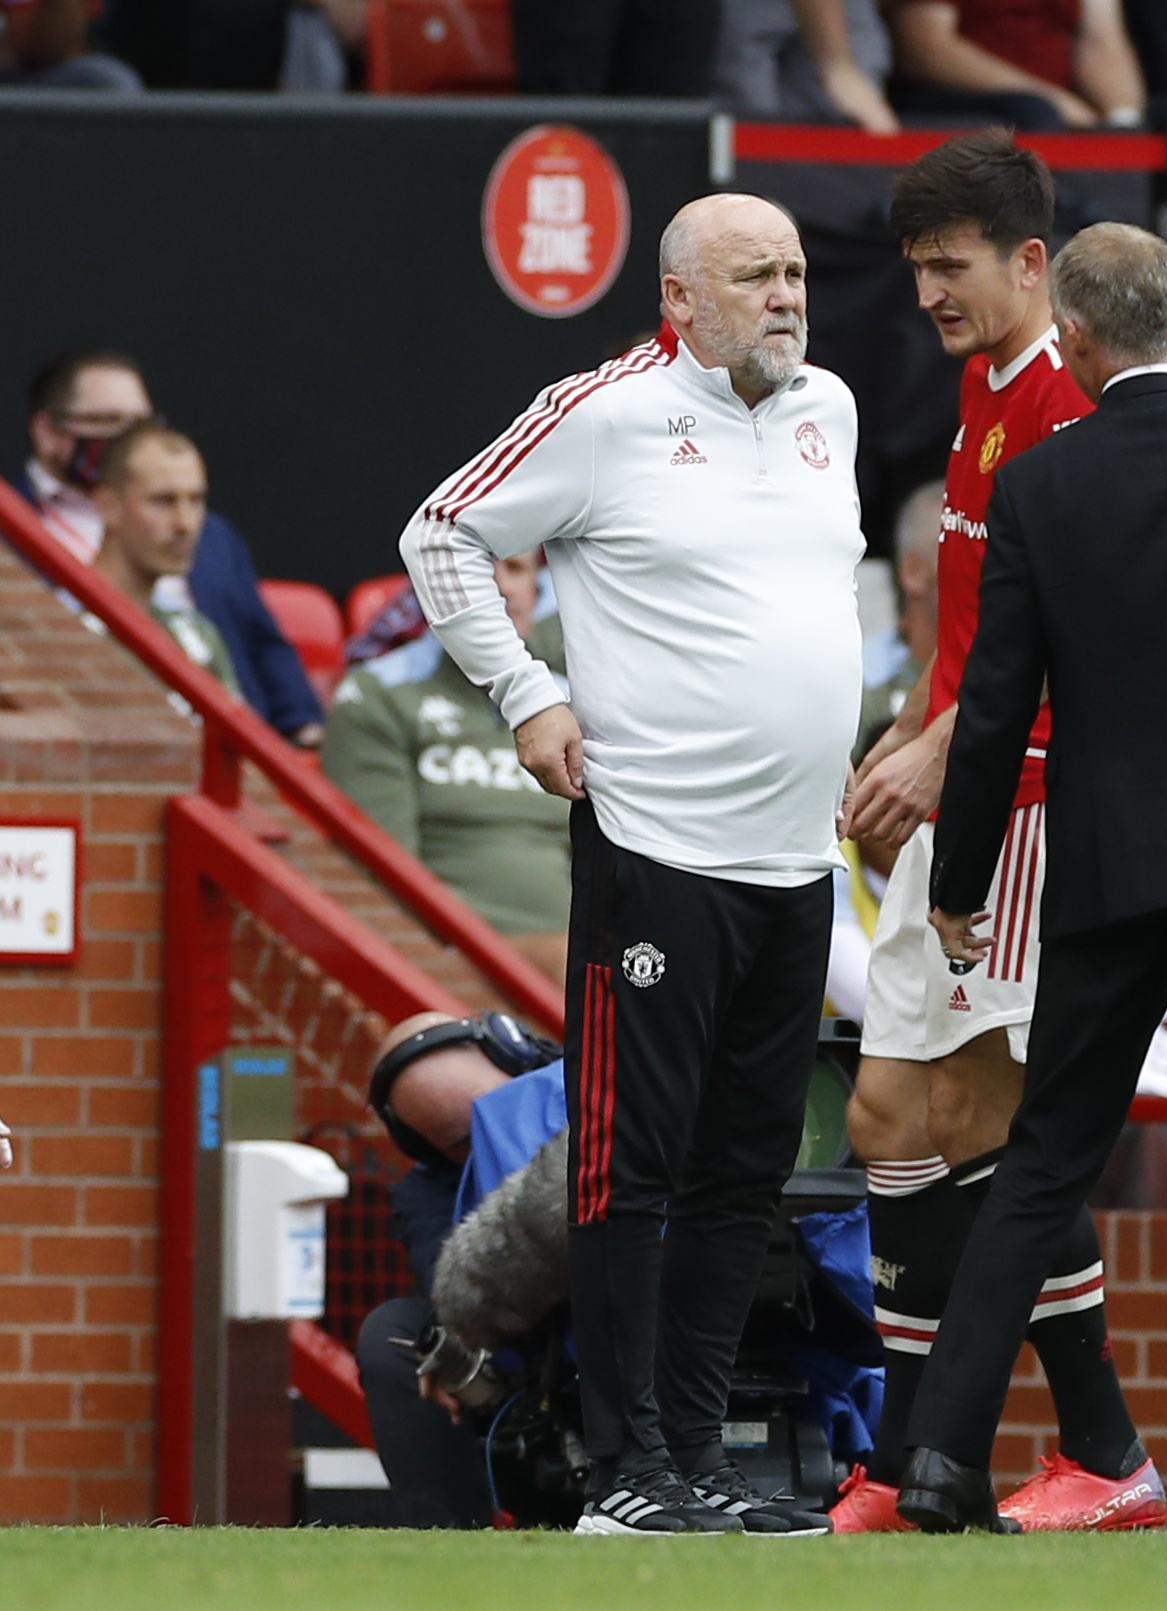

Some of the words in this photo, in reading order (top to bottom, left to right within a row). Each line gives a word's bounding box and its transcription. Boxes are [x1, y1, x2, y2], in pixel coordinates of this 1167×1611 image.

[526, 173, 586, 222] RED
[518, 222, 594, 274] ZONE
[667, 415, 697, 436] MP
[670, 453, 708, 466] adidas
[418, 744, 546, 794] CAZ
[1084, 1482, 1153, 1526] ULTRA
